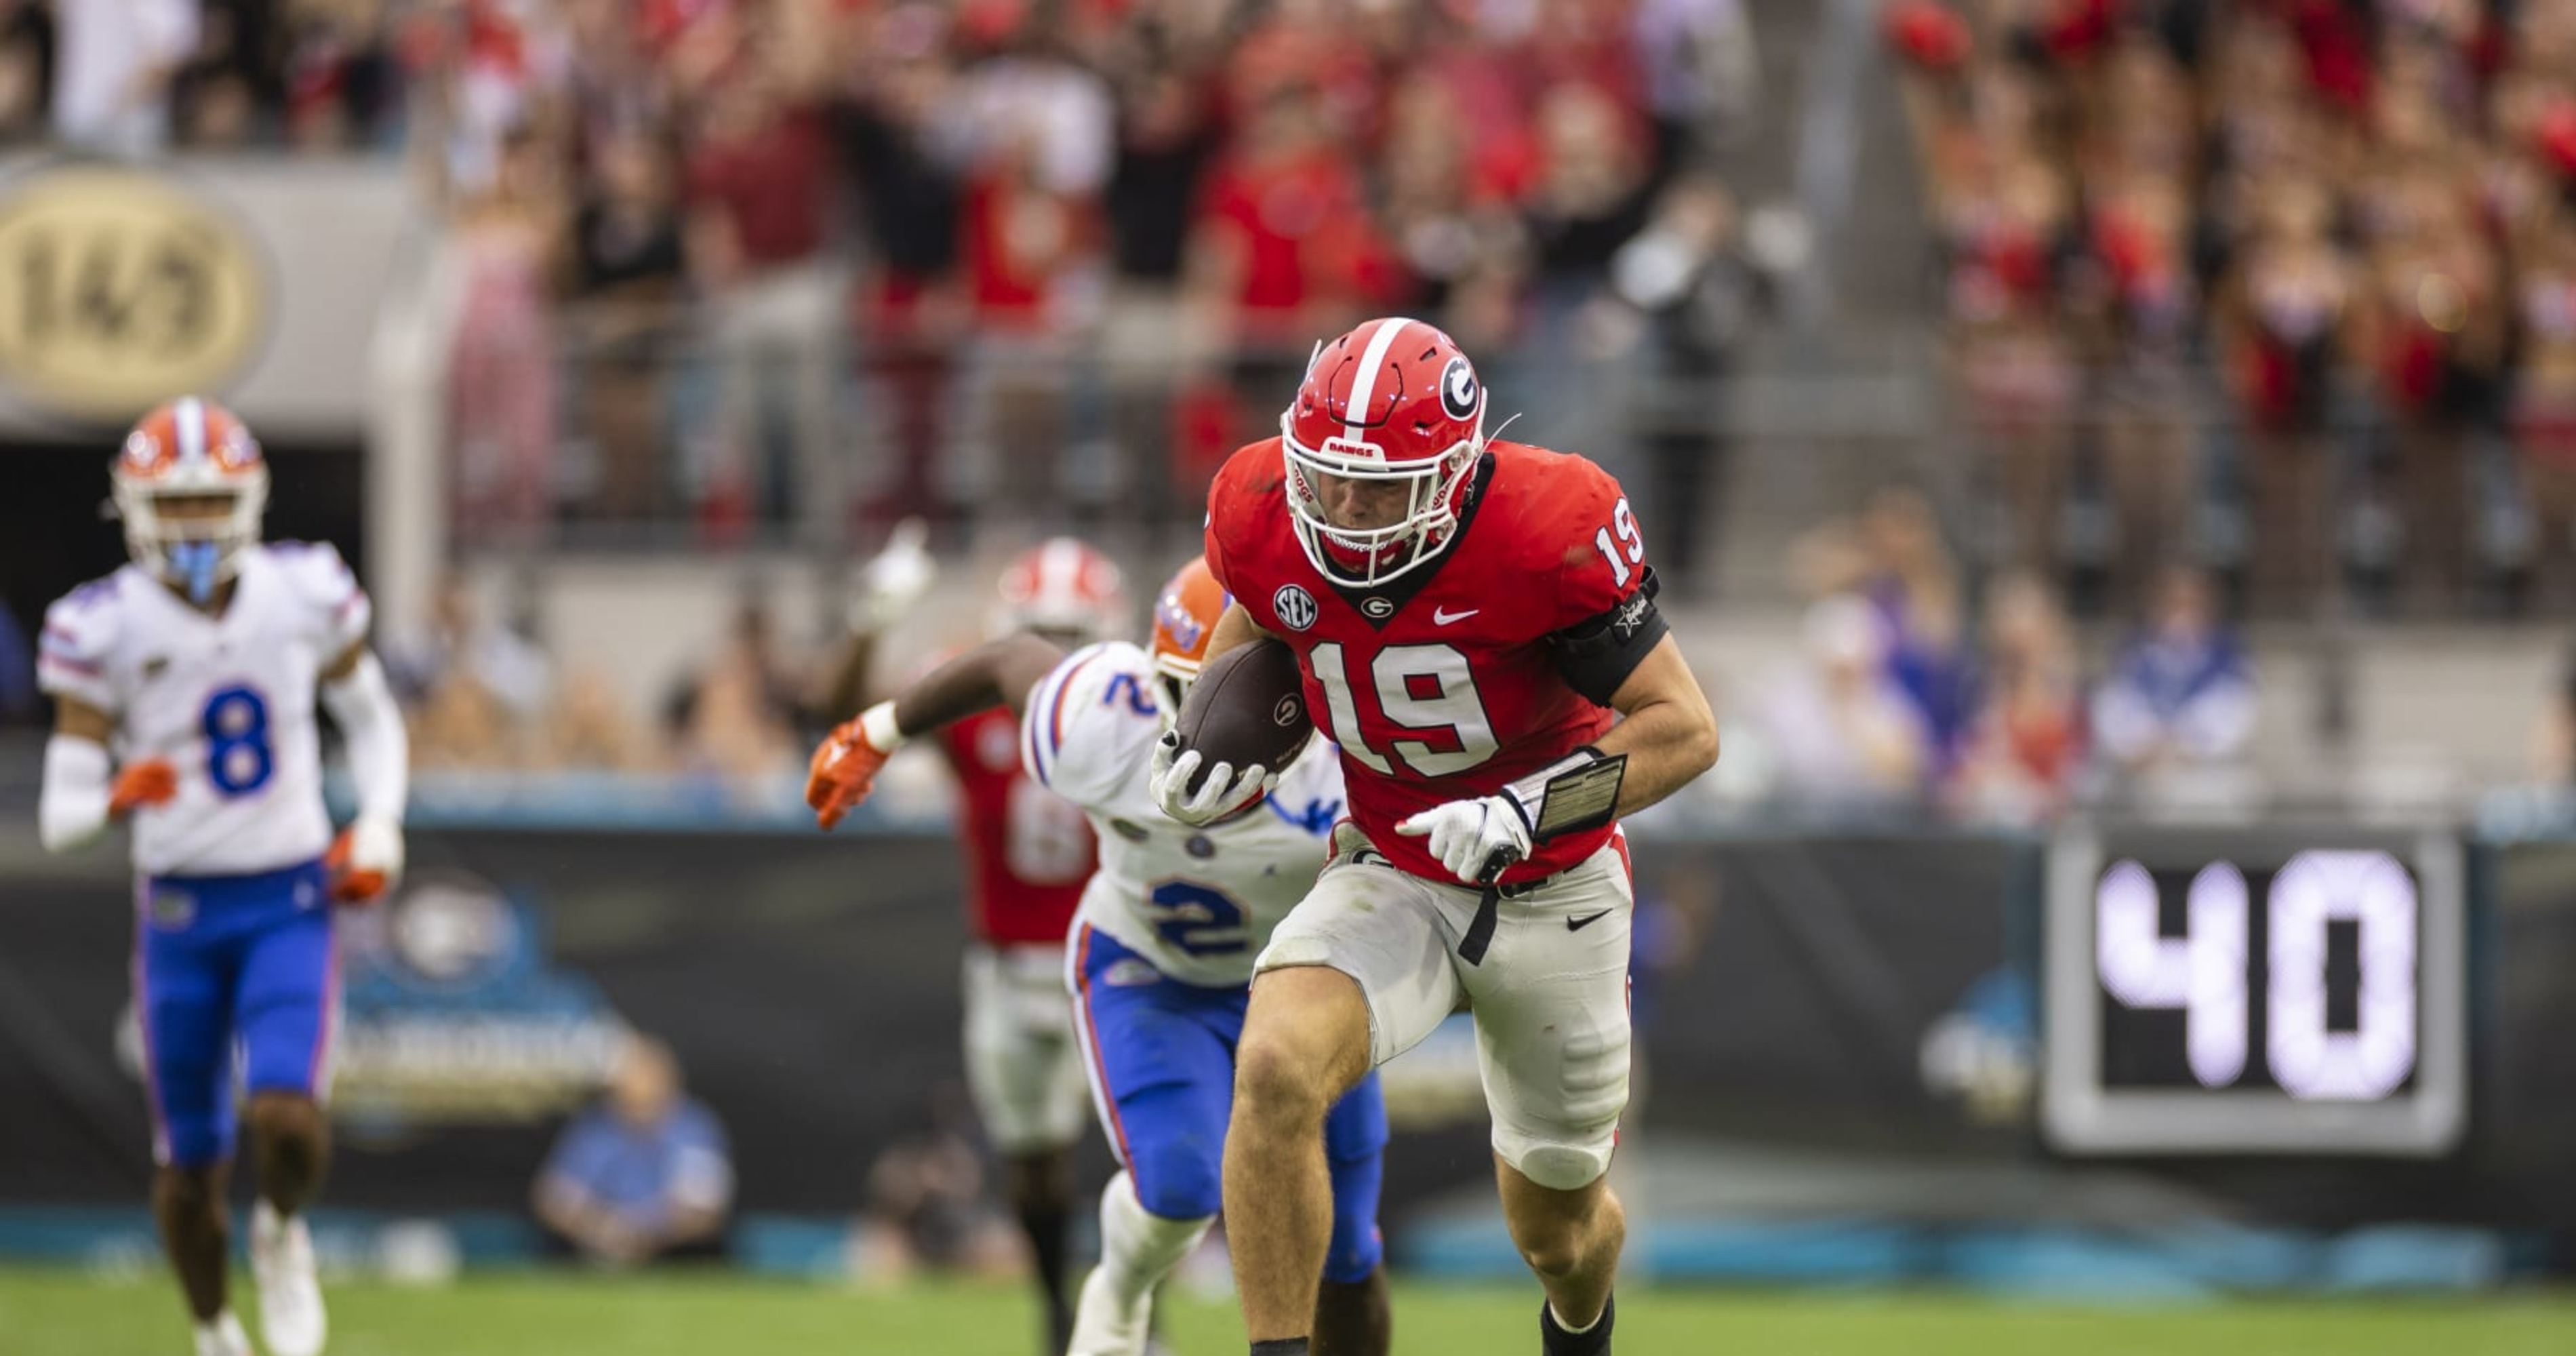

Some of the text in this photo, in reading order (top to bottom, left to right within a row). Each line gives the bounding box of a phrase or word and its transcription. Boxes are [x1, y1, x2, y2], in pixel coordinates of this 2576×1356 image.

[1329, 442, 1374, 458] DAWGS
[1594, 496, 1645, 590] 19
[1276, 587, 1314, 628] SEC
[1368, 601, 1393, 614] G
[1101, 672, 1159, 719] 2
[1309, 641, 1500, 778] 19
[203, 683, 276, 799] 8
[1150, 877, 1250, 957] 2
[2097, 849, 2417, 1100] 40
